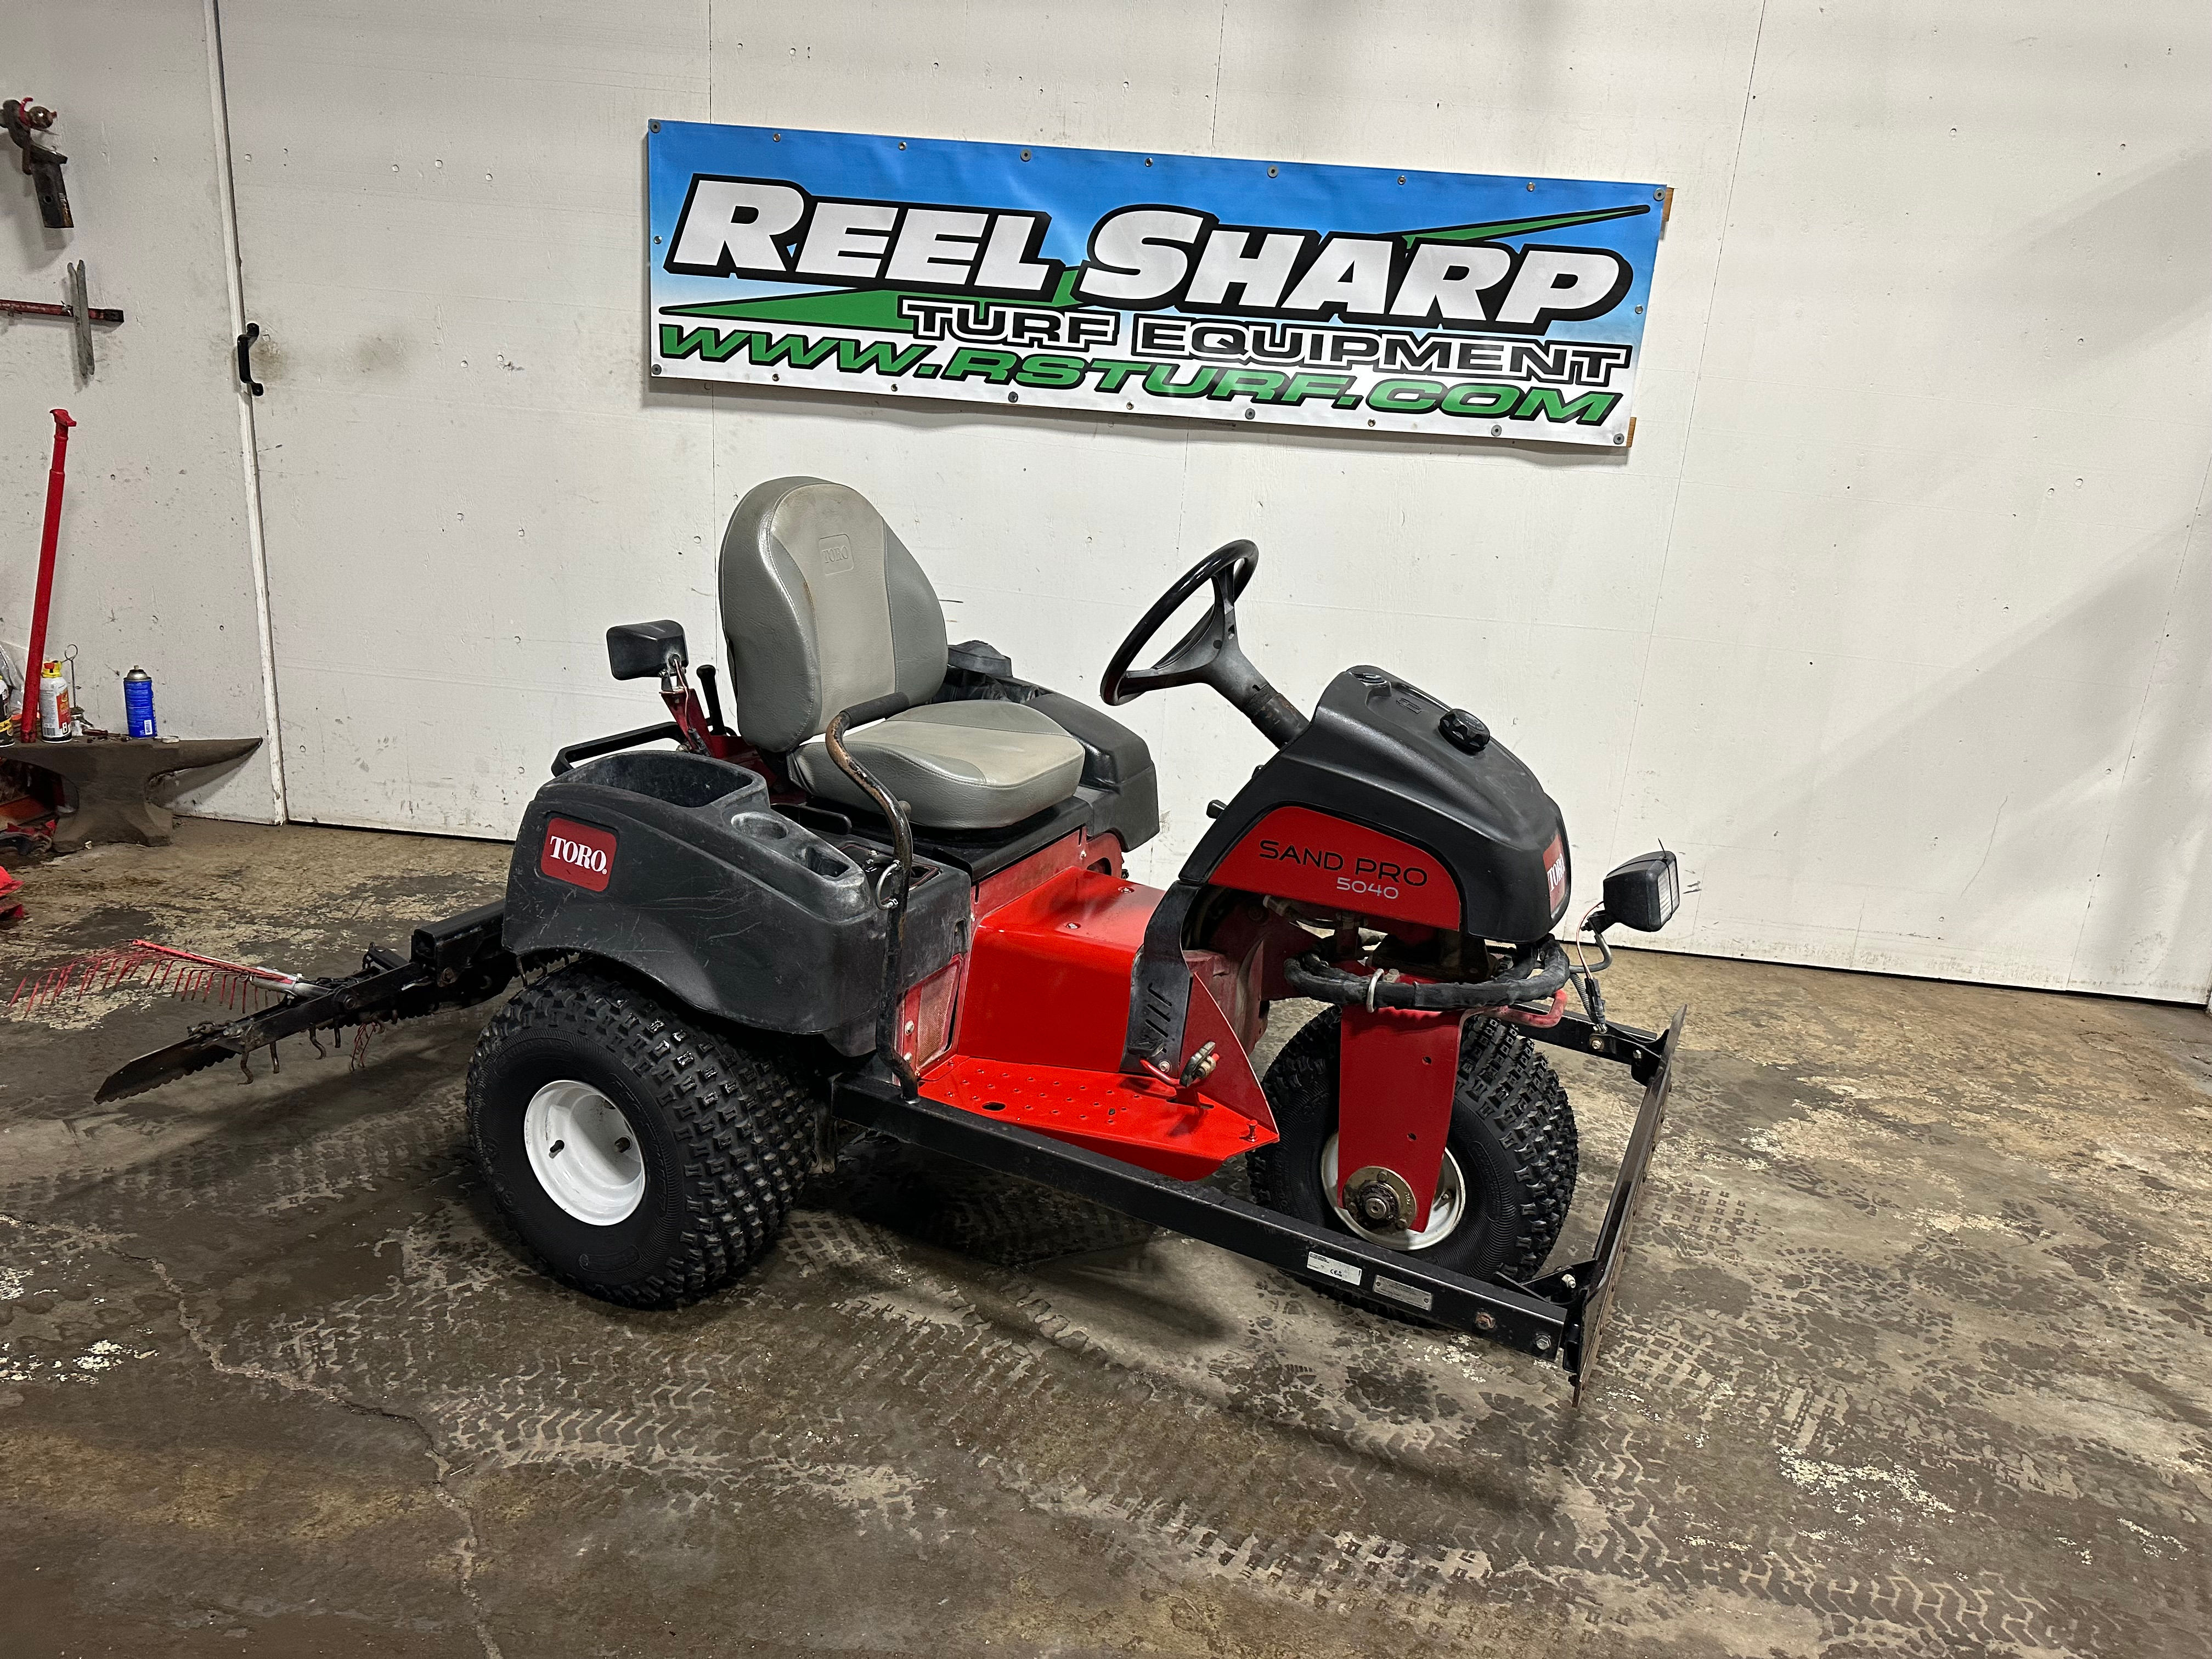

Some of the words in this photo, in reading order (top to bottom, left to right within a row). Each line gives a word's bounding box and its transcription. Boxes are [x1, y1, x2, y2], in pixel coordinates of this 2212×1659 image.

[667, 176, 1054, 296] REEL
[1075, 206, 1625, 328] SHARP
[905, 302, 1115, 350] TURF
[1138, 320, 1624, 382] EQUIPMENT
[659, 325, 1623, 425] WWW.RSTURF.COM
[822, 545, 848, 563] TORO
[1259, 839, 1344, 871] SAND
[1355, 857, 1428, 887] PRO
[1336, 877, 1400, 900] 5040
